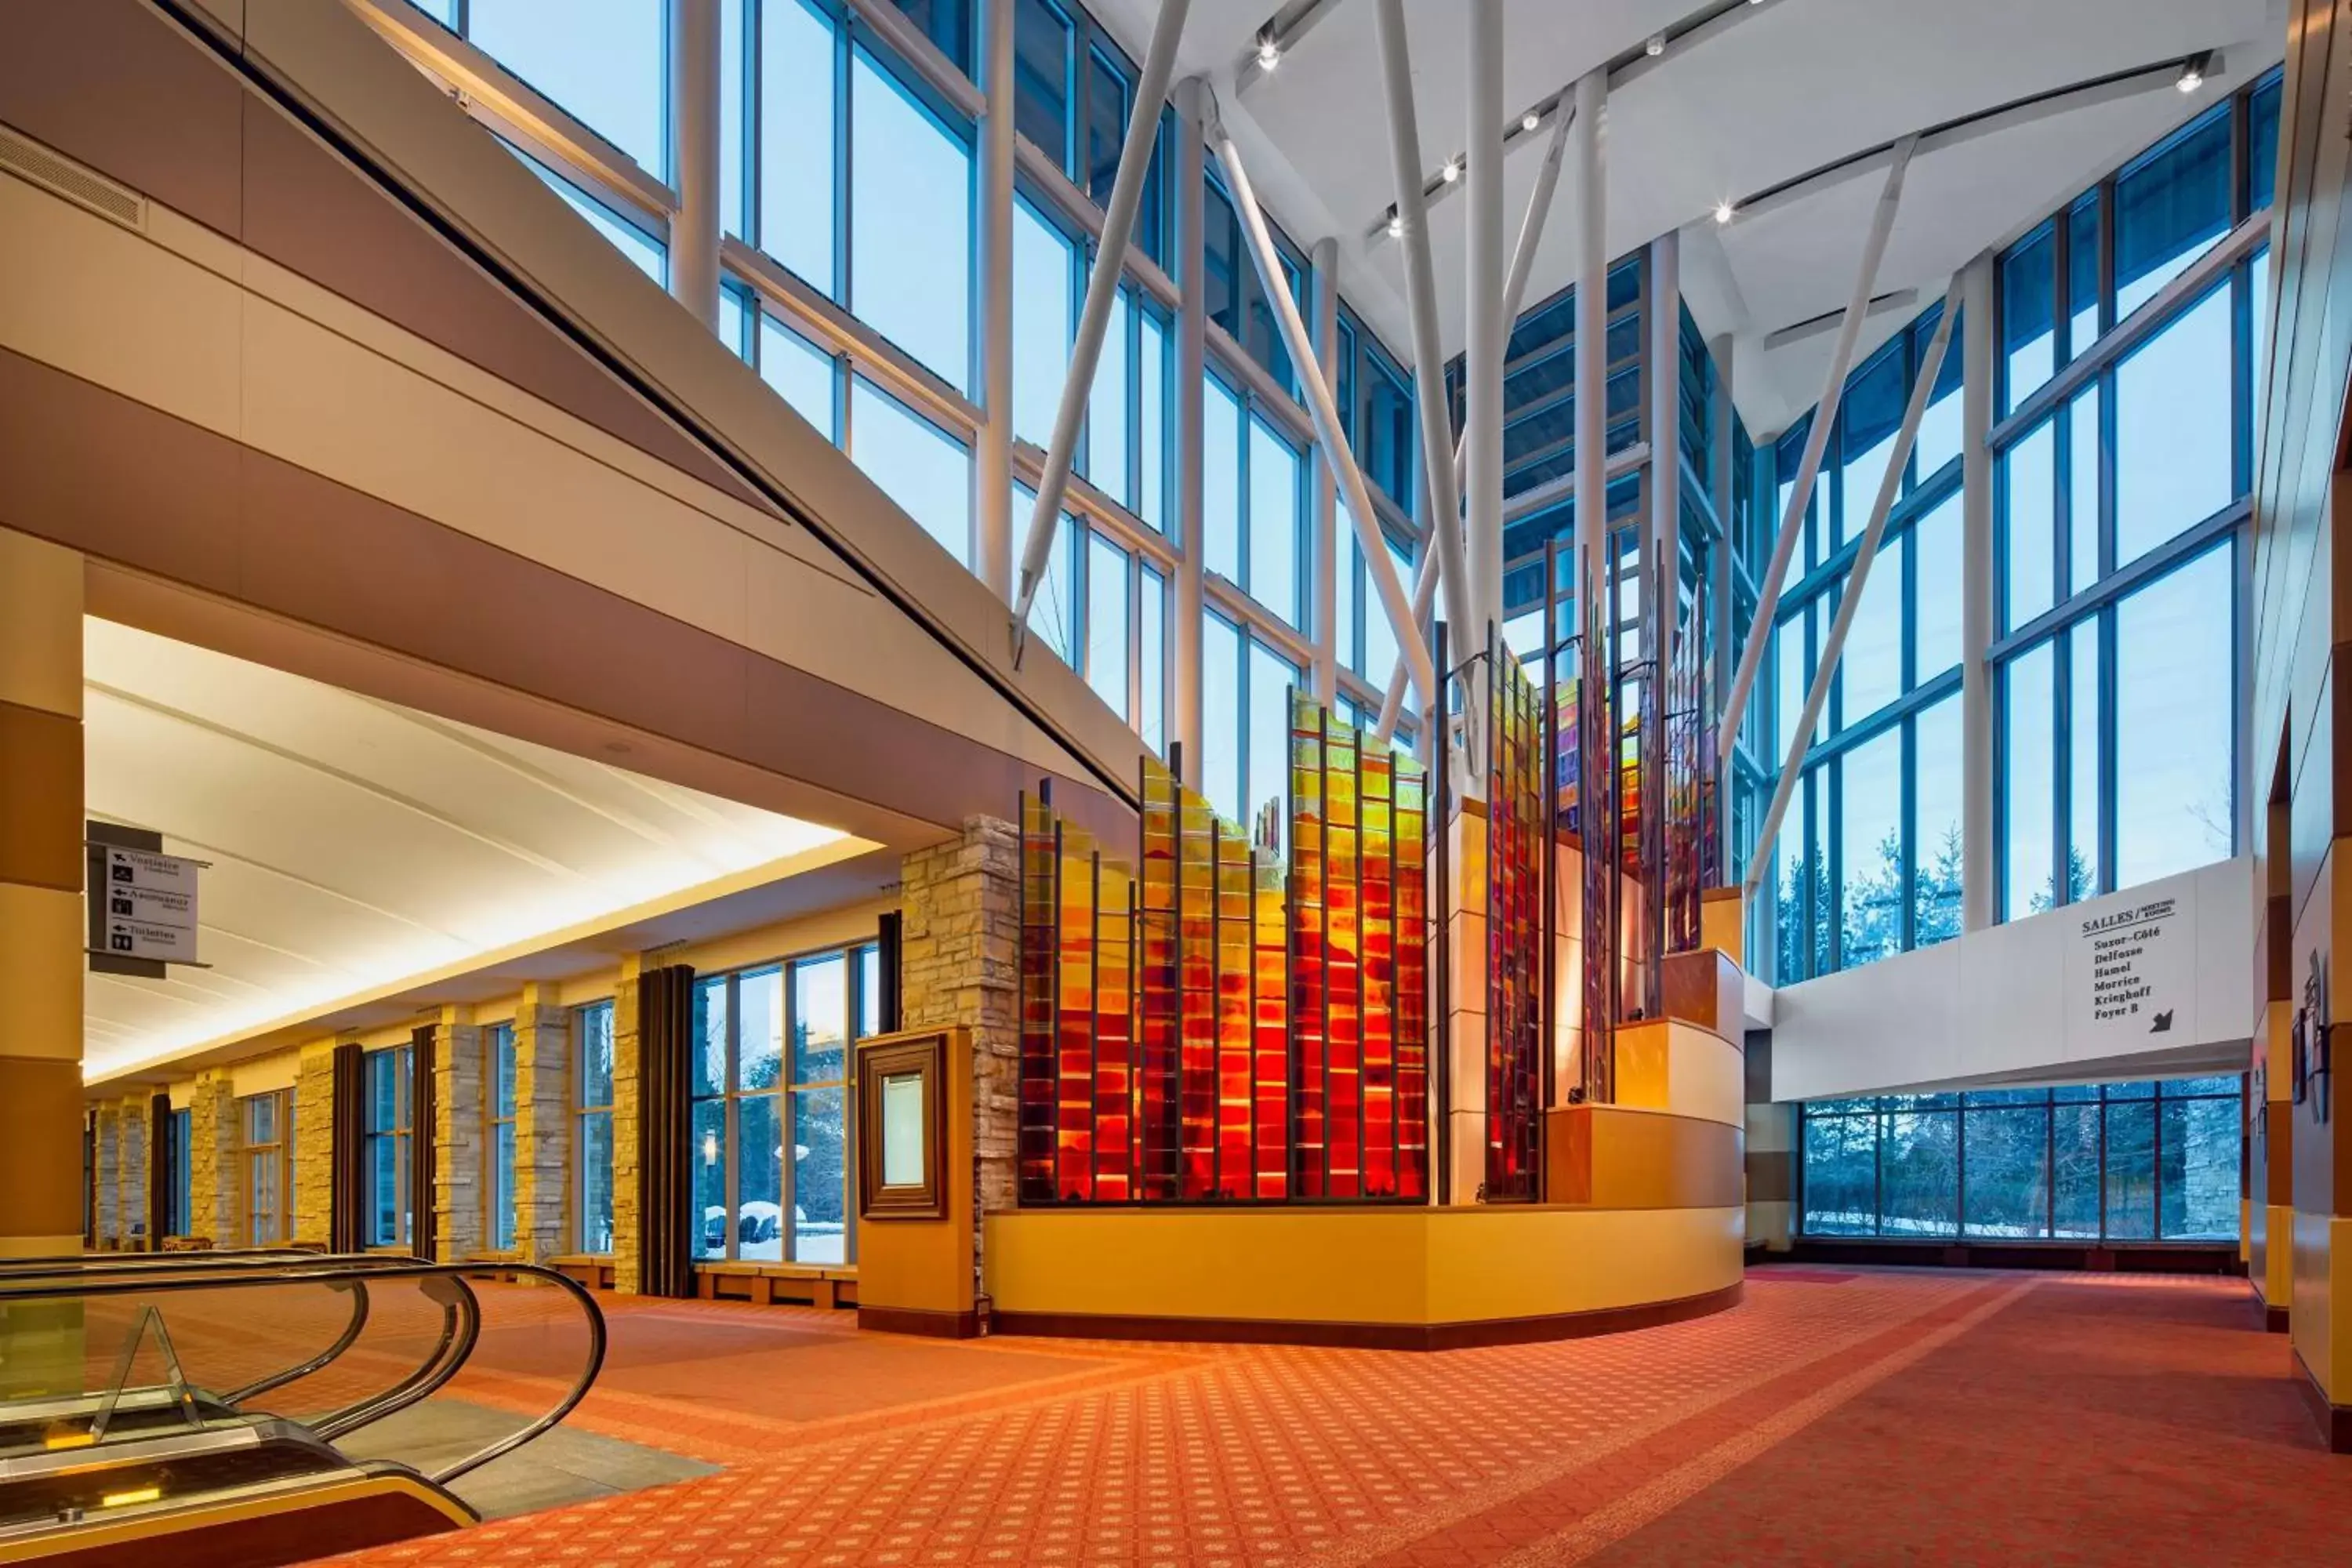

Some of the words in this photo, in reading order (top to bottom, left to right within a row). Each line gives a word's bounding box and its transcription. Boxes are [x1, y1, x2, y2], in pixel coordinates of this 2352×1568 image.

[2095, 962, 2131, 978] Hamel
[2095, 976, 2140, 992] Morrice
[2095, 1006, 2127, 1020] Foyer
